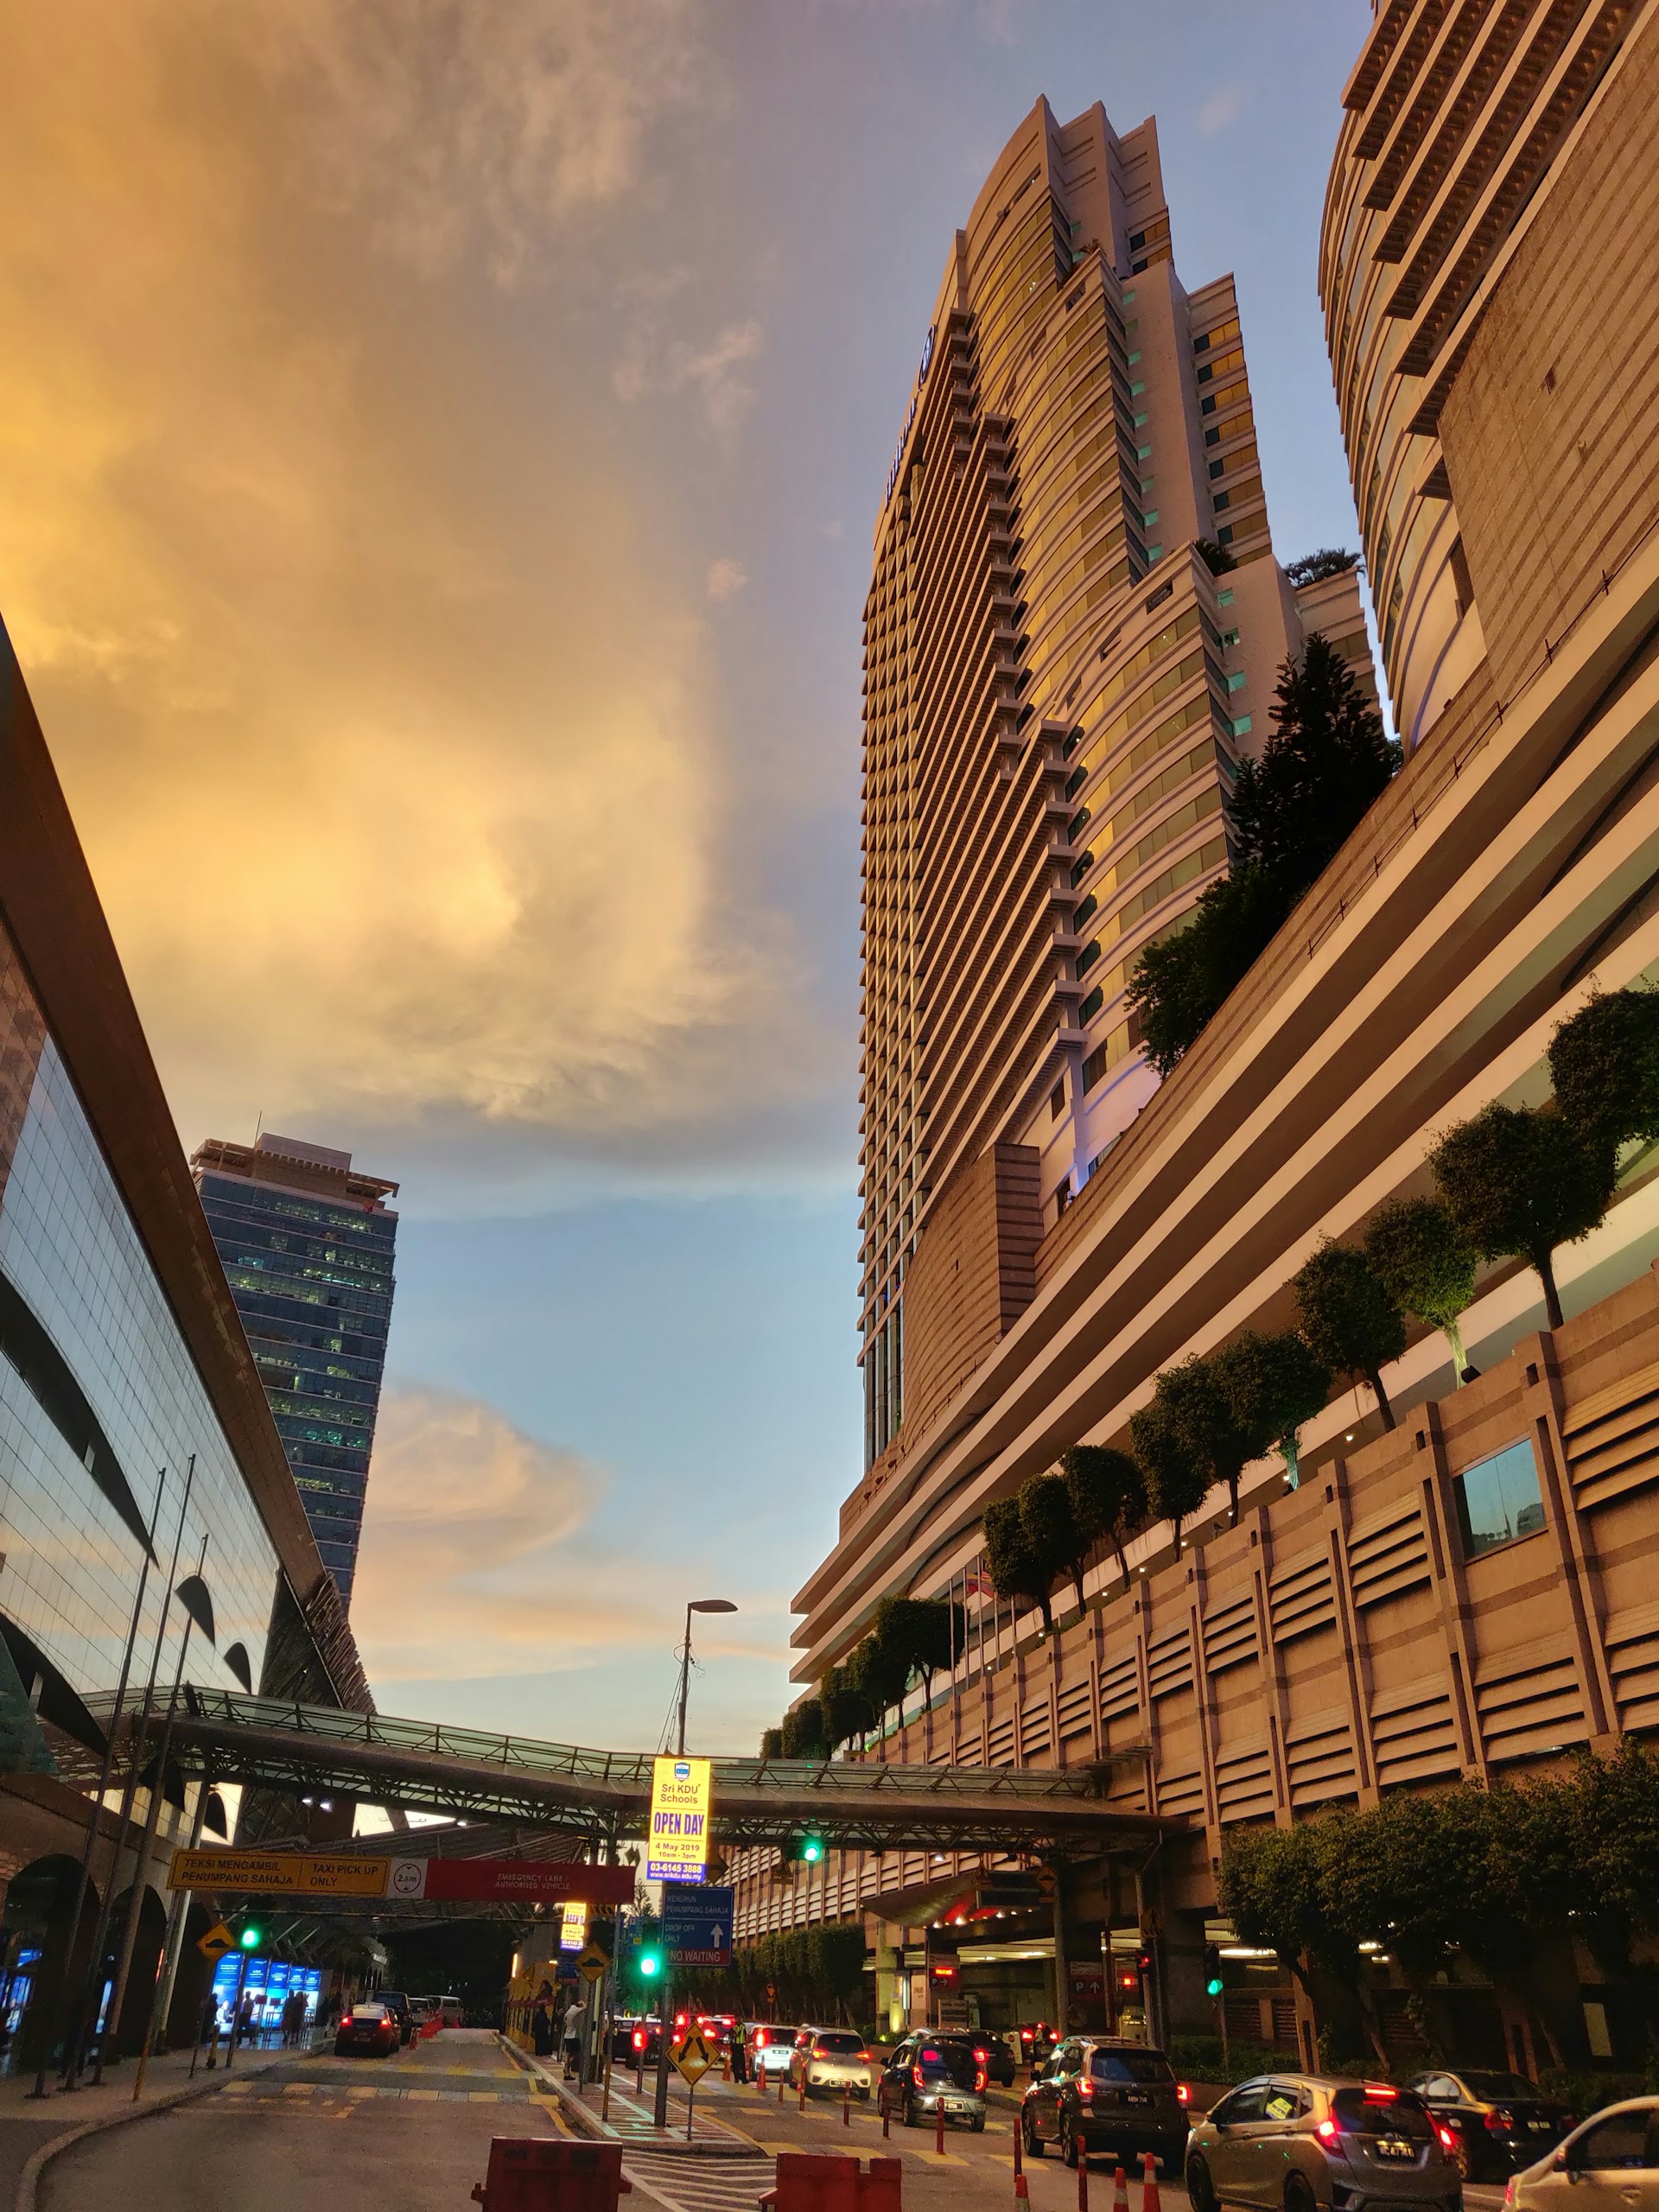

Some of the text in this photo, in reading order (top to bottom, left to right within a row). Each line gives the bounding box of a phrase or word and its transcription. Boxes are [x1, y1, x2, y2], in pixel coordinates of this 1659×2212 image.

[662, 1783, 698, 1794] Sri KDU
[660, 1794, 698, 1804] Schools
[654, 1812, 704, 1836] OPEN DAY
[663, 1843, 678, 1852] May
[185, 1858, 281, 1872] TEKSI MENGAMBIL
[313, 1864, 378, 1876] TAXI PICK UP
[650, 1863, 702, 1873] 03-6145 3888
[181, 1871, 293, 1885] PENUMPANG SAHAJA
[310, 1877, 338, 1887] ONLY
[664, 1935, 681, 1943] ONLY
[670, 1950, 721, 1962] NO WAITING
[1076, 1981, 1084, 1992] P
